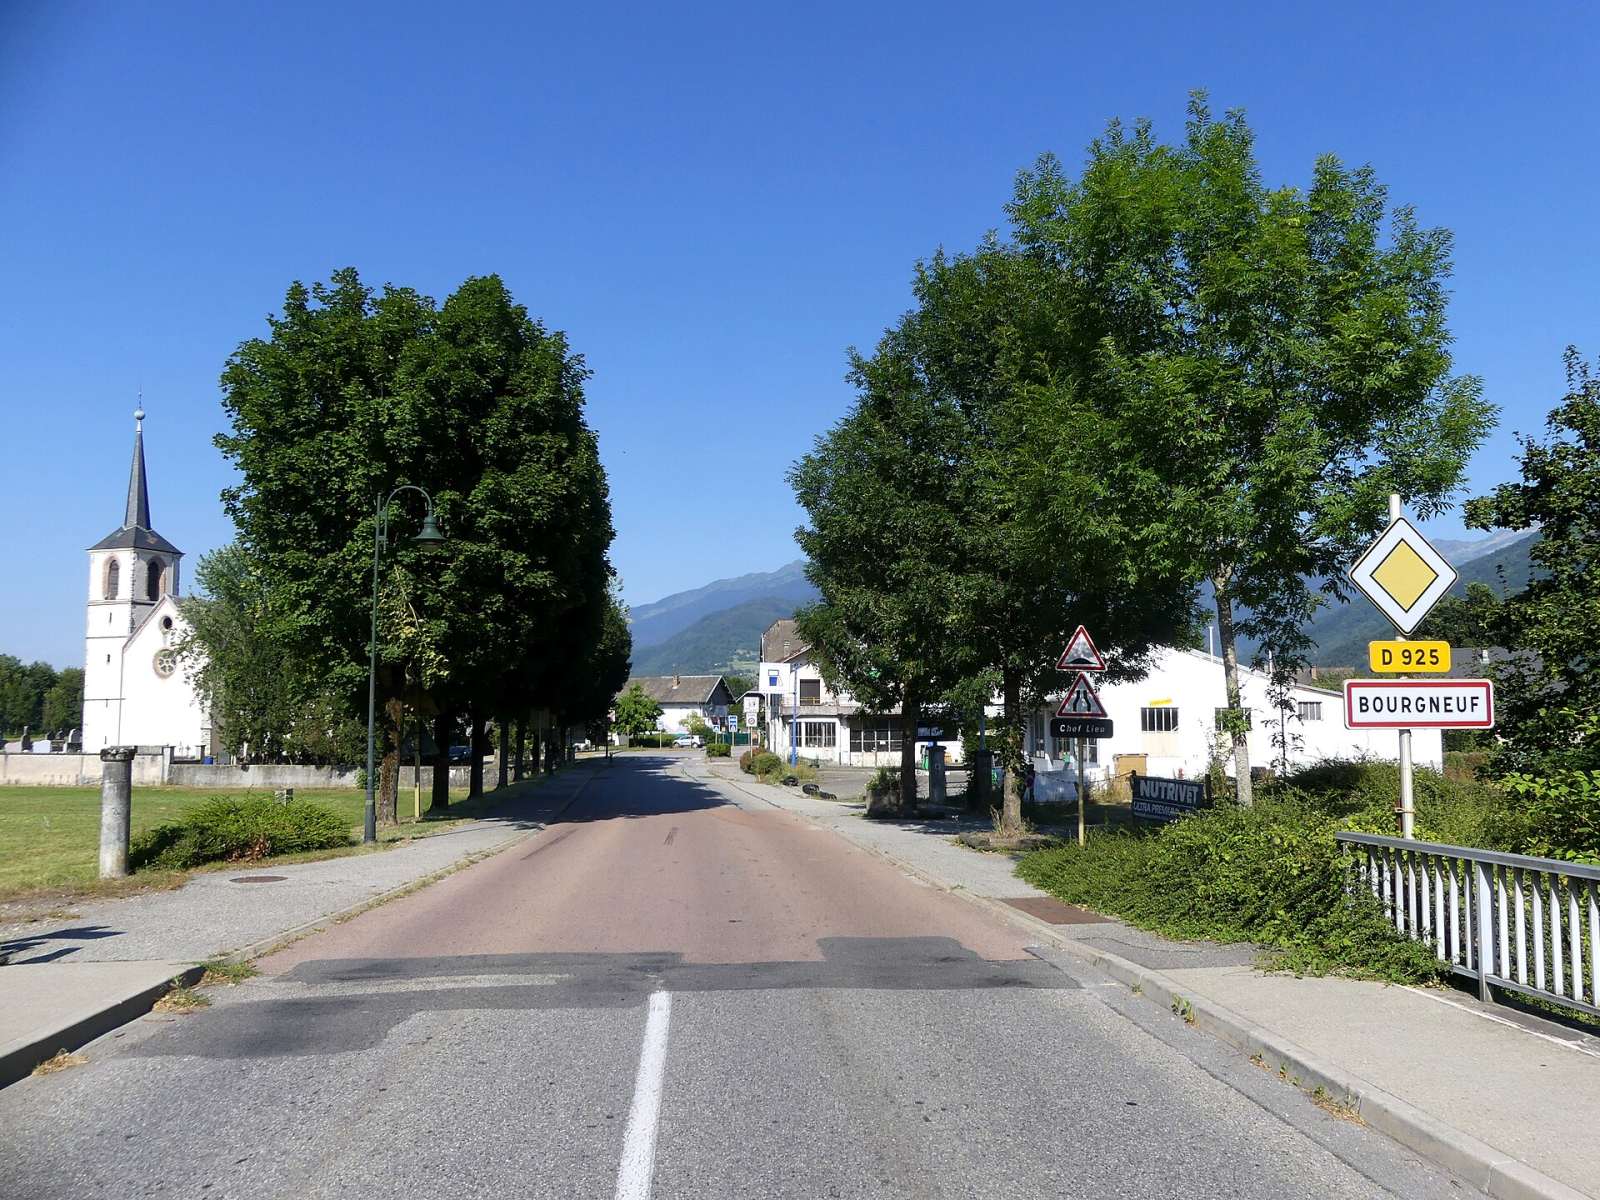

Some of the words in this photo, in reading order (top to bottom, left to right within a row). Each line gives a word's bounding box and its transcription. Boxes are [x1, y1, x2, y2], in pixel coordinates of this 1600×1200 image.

[1381, 649, 1393, 666] D
[1401, 649, 1440, 666] 925
[1359, 696, 1480, 713] BOURGNEUF
[1060, 724, 1082, 733] Chef
[1086, 725, 1105, 733] Lieu
[1140, 779, 1199, 804] NUTRIVET
